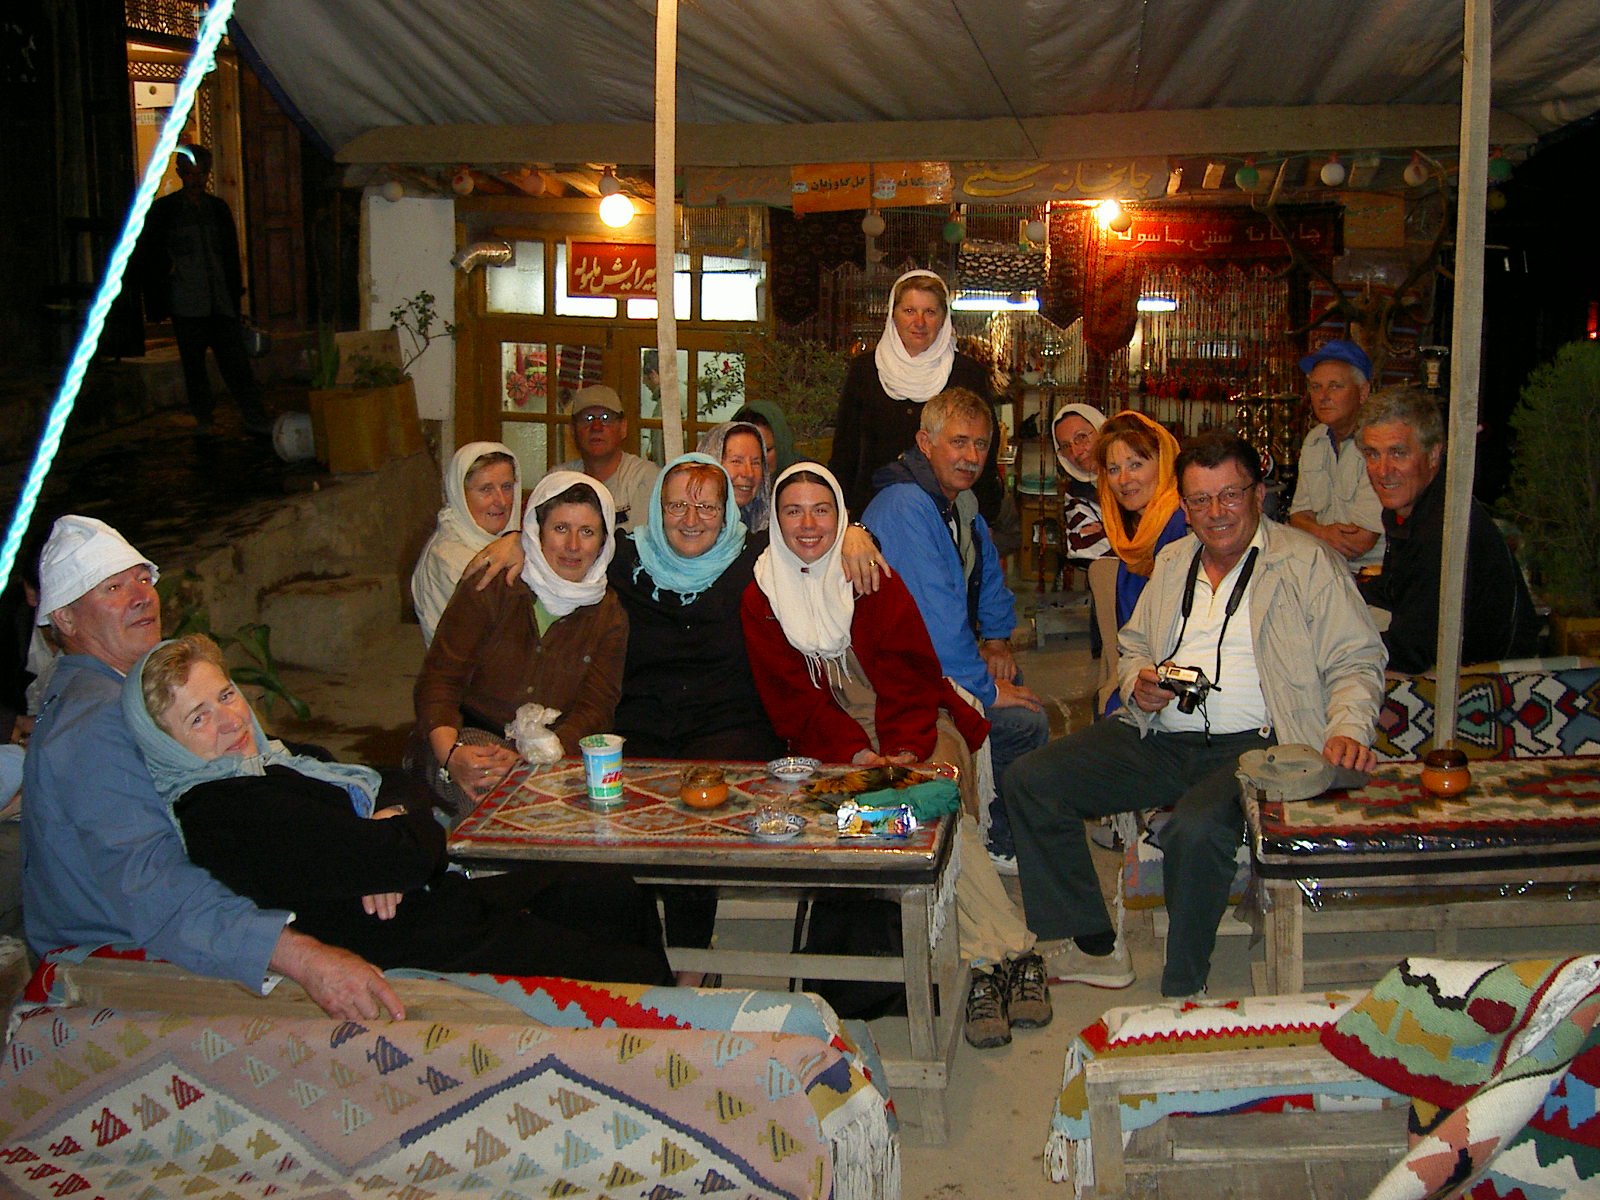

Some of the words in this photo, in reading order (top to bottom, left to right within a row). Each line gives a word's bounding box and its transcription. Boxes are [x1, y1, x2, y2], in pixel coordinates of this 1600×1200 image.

[962, 162, 1050, 197] سنتی
[1052, 161, 1150, 197] چایخانه
[1189, 230, 1233, 251] سنتی
[1245, 222, 1322, 245] چایانه
